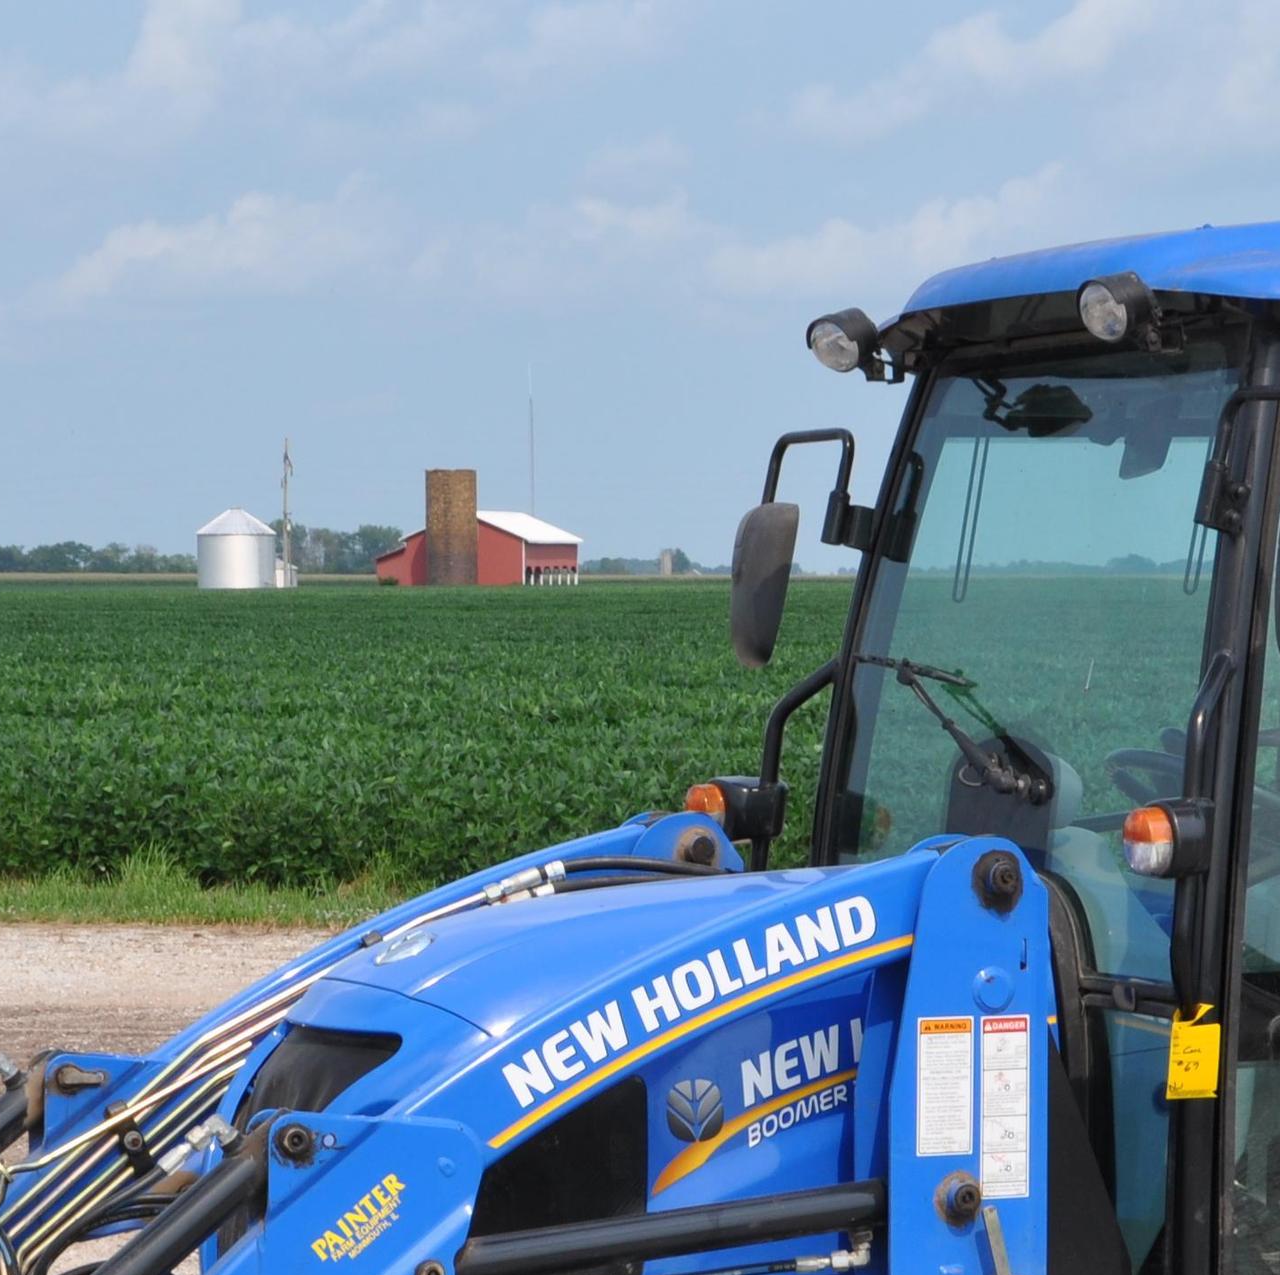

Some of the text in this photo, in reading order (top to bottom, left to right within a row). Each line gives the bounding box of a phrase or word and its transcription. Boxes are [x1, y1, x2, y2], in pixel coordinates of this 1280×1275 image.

[502, 895, 876, 1108] NEW HOLLAND
[934, 1022, 967, 1030] WARNING
[991, 1021, 1025, 1031] DANGER
[741, 1024, 839, 1107] NEW
[747, 1084, 848, 1148] BOOMER
[311, 1173, 406, 1261] PAINTER
[355, 1194, 401, 1240] EQUIPMENT
